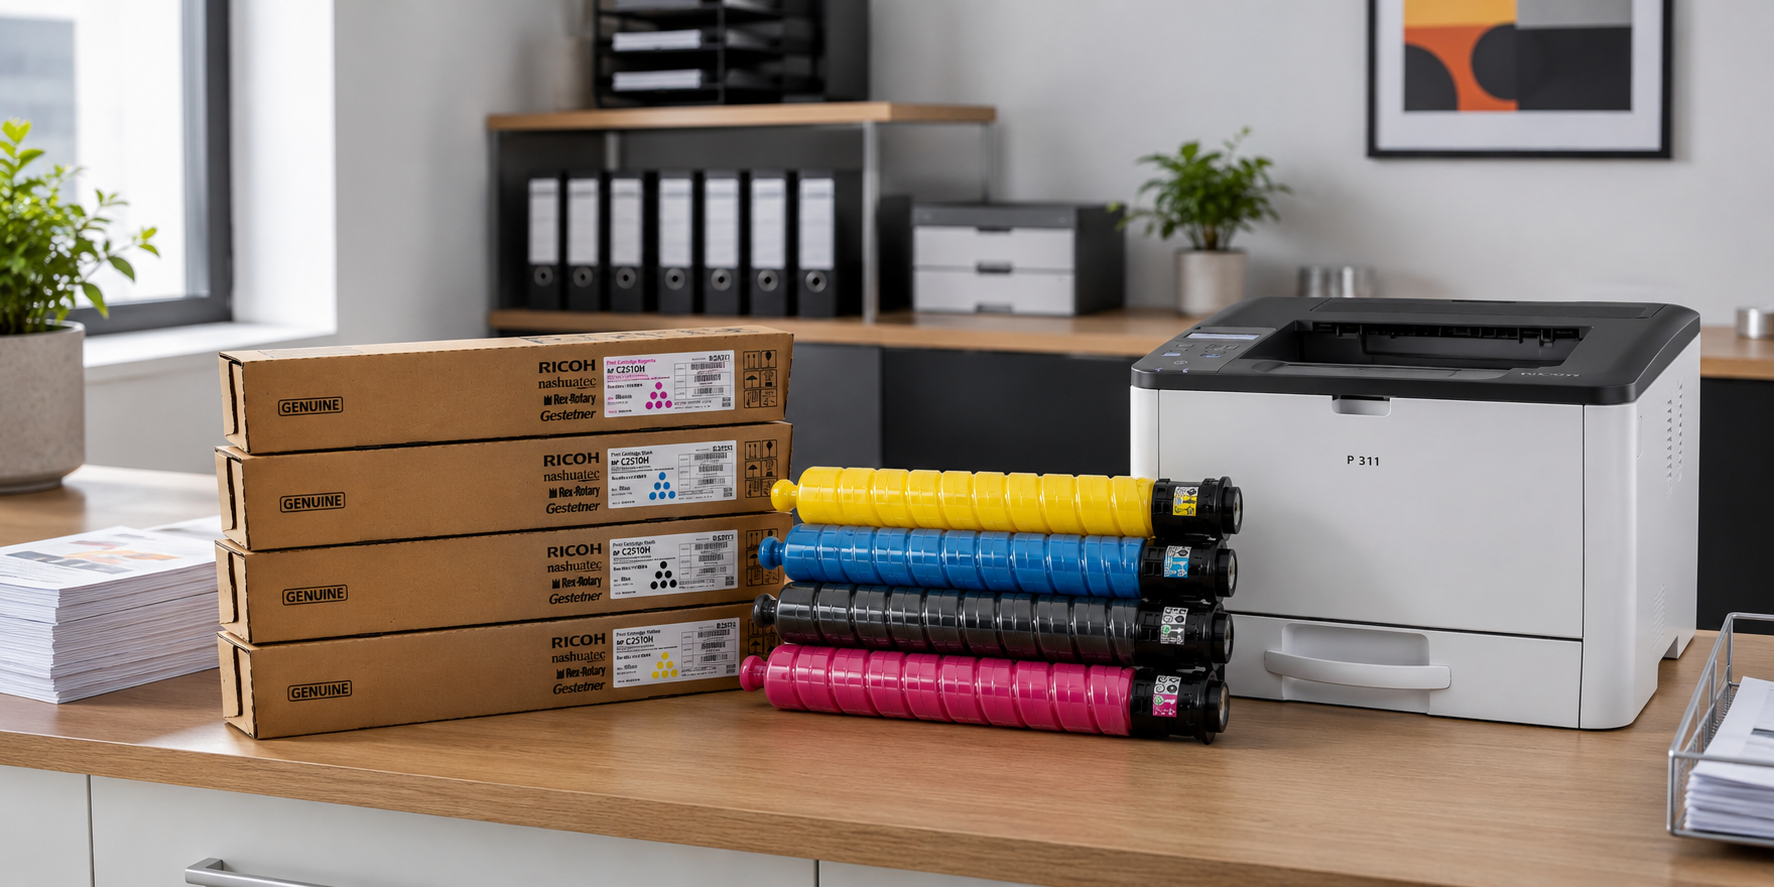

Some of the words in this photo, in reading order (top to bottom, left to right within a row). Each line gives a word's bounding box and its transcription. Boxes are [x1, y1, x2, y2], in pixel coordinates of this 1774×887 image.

[538, 359, 596, 374] RICOH
[538, 376, 597, 389] nashuatec
[281, 399, 340, 413] GENUINE
[540, 409, 597, 422] Gestetner
[543, 451, 600, 467] RICOH
[1347, 455, 1355, 465] P
[1359, 456, 1379, 467] 311
[543, 469, 600, 482] nashuatec
[283, 495, 342, 510] GENUINE
[545, 502, 601, 514] Gestetner
[547, 543, 602, 558] RICOH
[547, 560, 602, 573] nashuatec
[286, 587, 344, 602] GENUINE
[549, 592, 603, 605] Gestetner
[552, 632, 606, 649] RICOH
[552, 650, 606, 663] nashuatec
[291, 683, 349, 699] GENUINE
[552, 681, 606, 695] Gestetner
